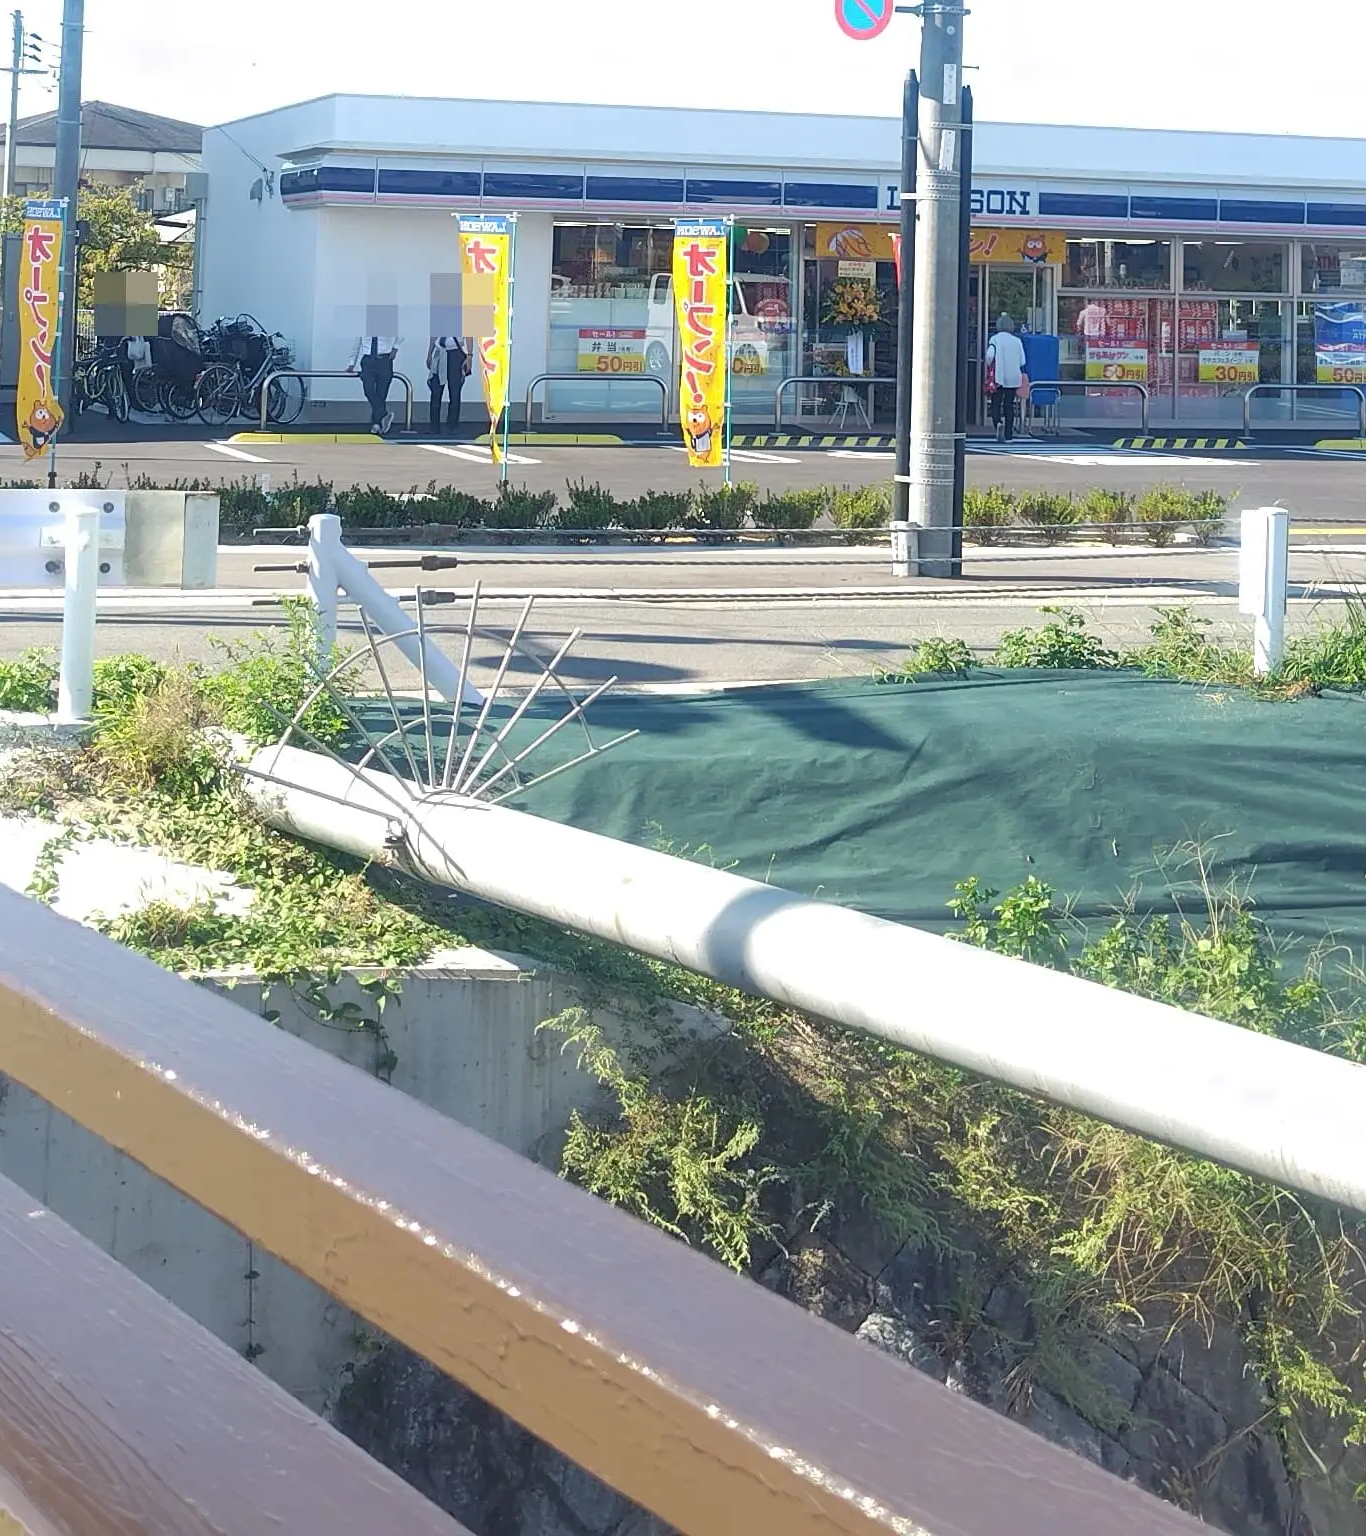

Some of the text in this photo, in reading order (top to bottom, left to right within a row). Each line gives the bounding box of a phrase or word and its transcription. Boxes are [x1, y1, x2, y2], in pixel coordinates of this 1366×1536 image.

[887, 186, 1030, 215] LSON
[596, 355, 643, 373] 50円引
[1215, 366, 1255, 381] 30円引
